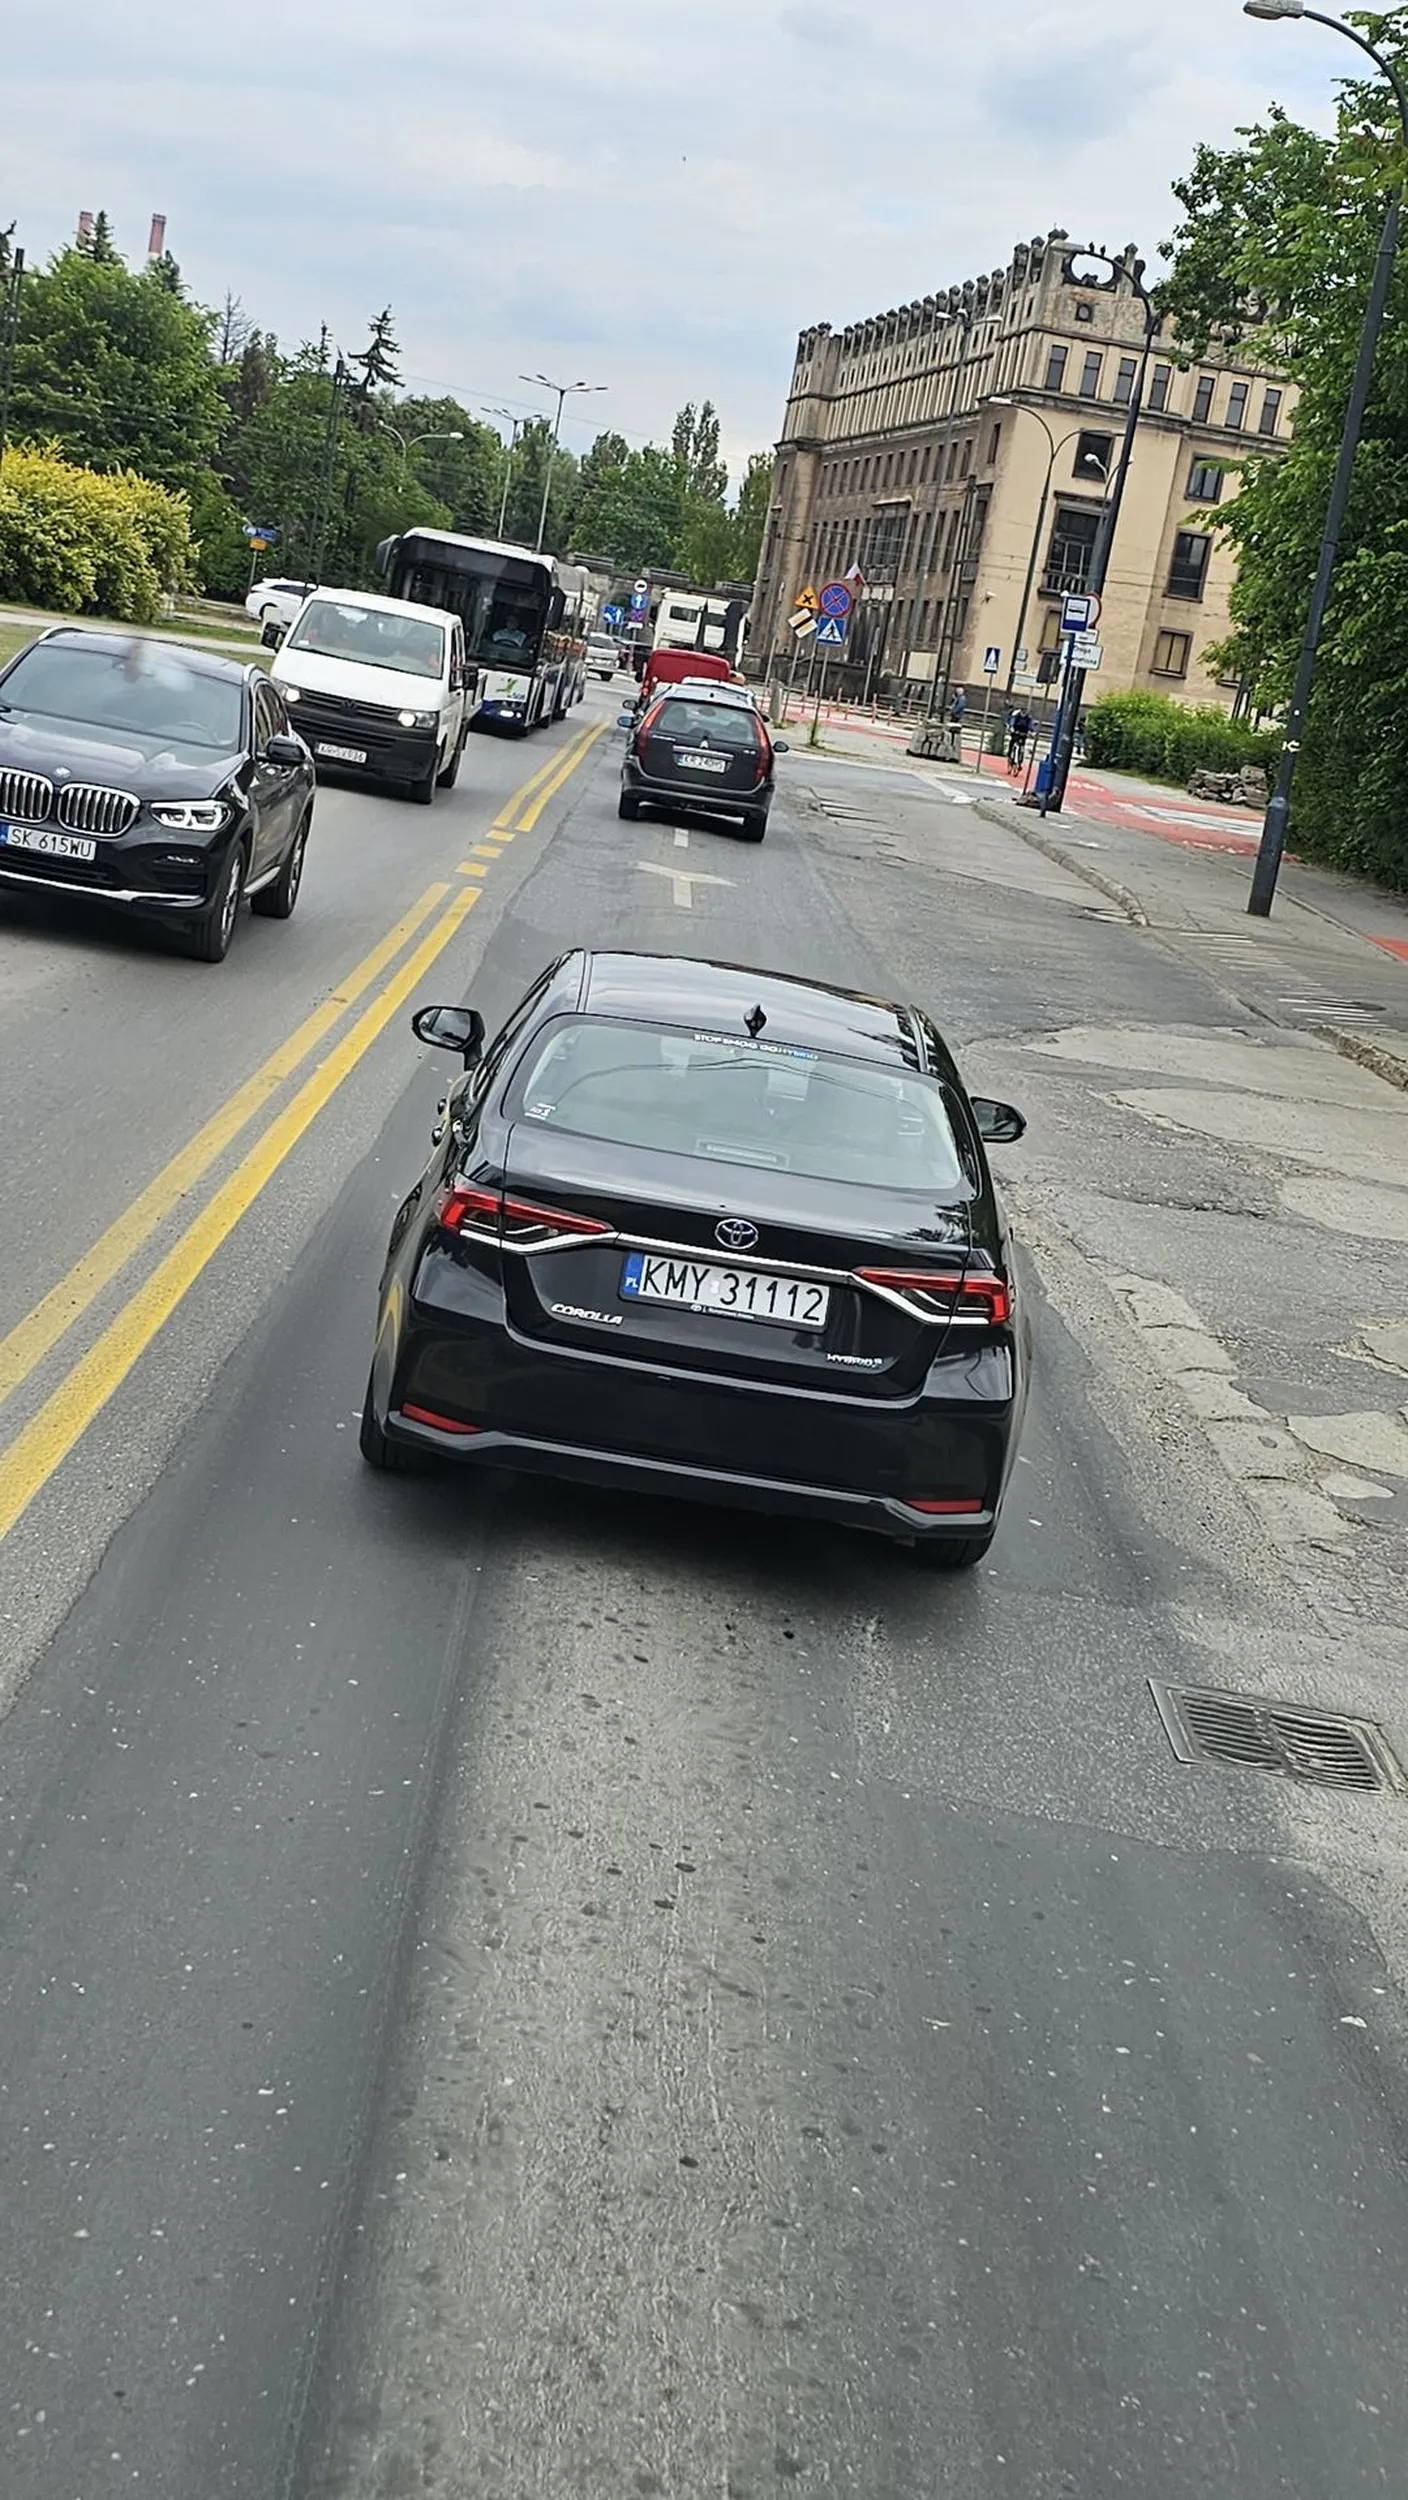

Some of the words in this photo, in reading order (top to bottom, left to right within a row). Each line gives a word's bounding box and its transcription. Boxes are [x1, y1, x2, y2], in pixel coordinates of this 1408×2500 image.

[11, 828, 34, 846] SK
[39, 834, 92, 857] 615WU
[694, 1033, 722, 1044] STOP
[625, 1276, 639, 1289] PL
[643, 1258, 710, 1301] KMY
[719, 1272, 823, 1322] 31112
[551, 1303, 623, 1325] COROLLA
